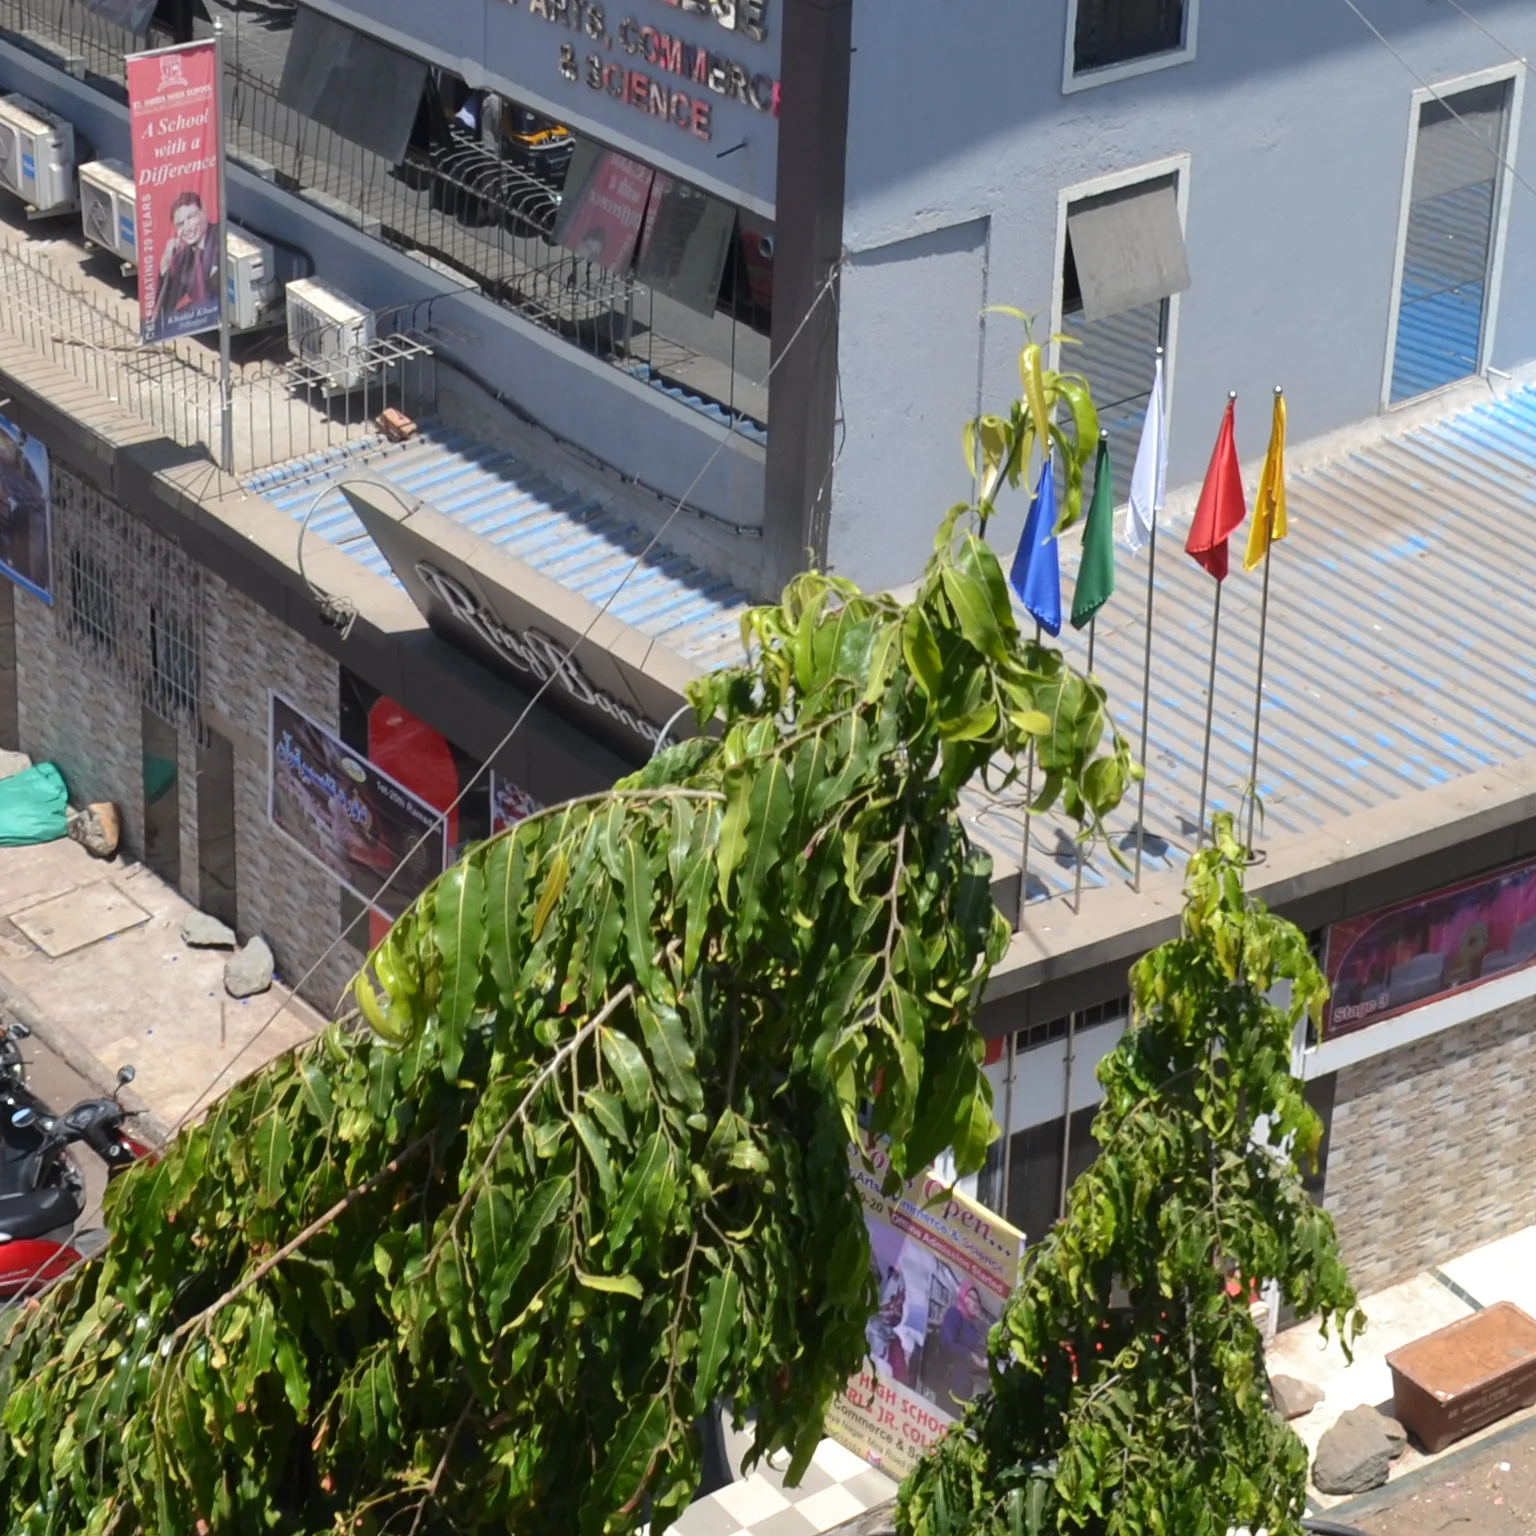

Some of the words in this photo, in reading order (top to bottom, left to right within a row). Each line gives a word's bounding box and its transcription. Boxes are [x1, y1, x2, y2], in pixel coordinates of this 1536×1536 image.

[585, 52, 713, 141] SCIENCE
[142, 122, 154, 139] A
[157, 107, 209, 136] School
[154, 137, 186, 158] with
[190, 138, 201, 150] a
[139, 155, 217, 186] Difference
[142, 193, 153, 237] YEARS
[144, 256, 157, 340] CELEBRATING
[1333, 998, 1377, 1023] Stage
[1378, 992, 1390, 1009] 3
[859, 1371, 897, 1406] HGH
[833, 1397, 893, 1444] Commerce
[895, 1438, 905, 1453] &
